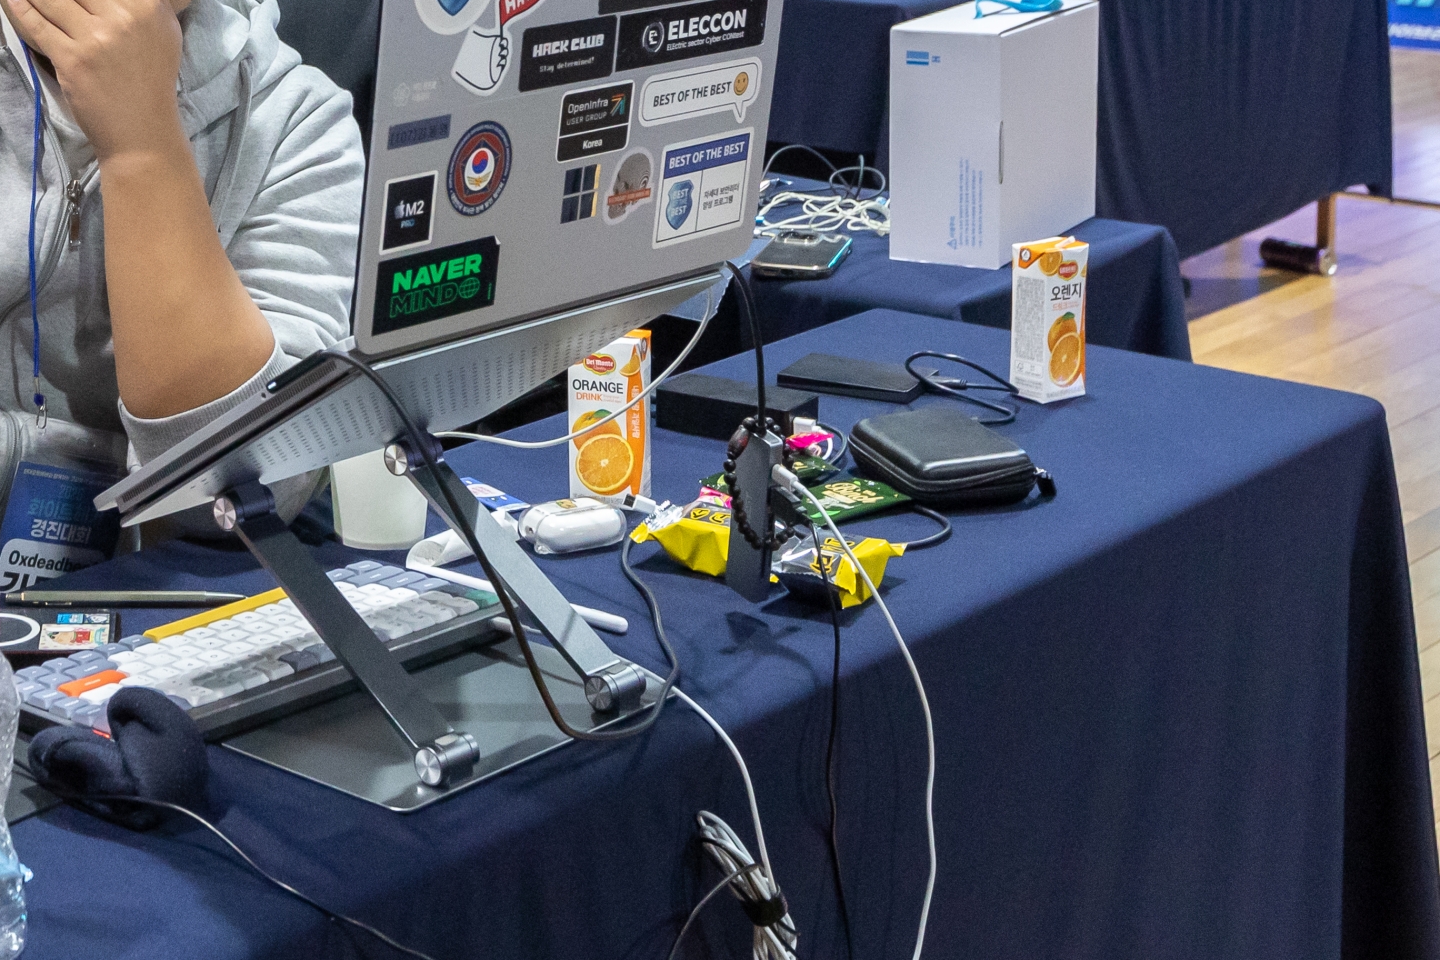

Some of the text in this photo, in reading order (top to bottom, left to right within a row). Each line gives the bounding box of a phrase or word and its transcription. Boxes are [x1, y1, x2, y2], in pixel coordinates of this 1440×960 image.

[667, 8, 747, 41] ELECCON
[532, 33, 605, 58] HACK CLUB
[653, 80, 732, 108] BEST OF THE BEST
[568, 98, 609, 115] OpenInfra
[566, 111, 607, 126] USER GROUP
[582, 138, 603, 150] Korea
[669, 141, 745, 170] BEST OF THE BEST
[672, 187, 690, 199] BEST
[703, 187, 719, 199] 차세대
[405, 200, 425, 217] M2
[713, 195, 734, 209] 프로그램
[670, 205, 687, 218] BEST
[400, 219, 415, 229] PRO
[392, 253, 482, 294] NAVER
[1050, 282, 1083, 301] 오렌지
[585, 358, 614, 368] Del Monte
[572, 378, 624, 395] ORANGE
[576, 391, 603, 401] DRINK
[31, 518, 92, 544] 경진대회
